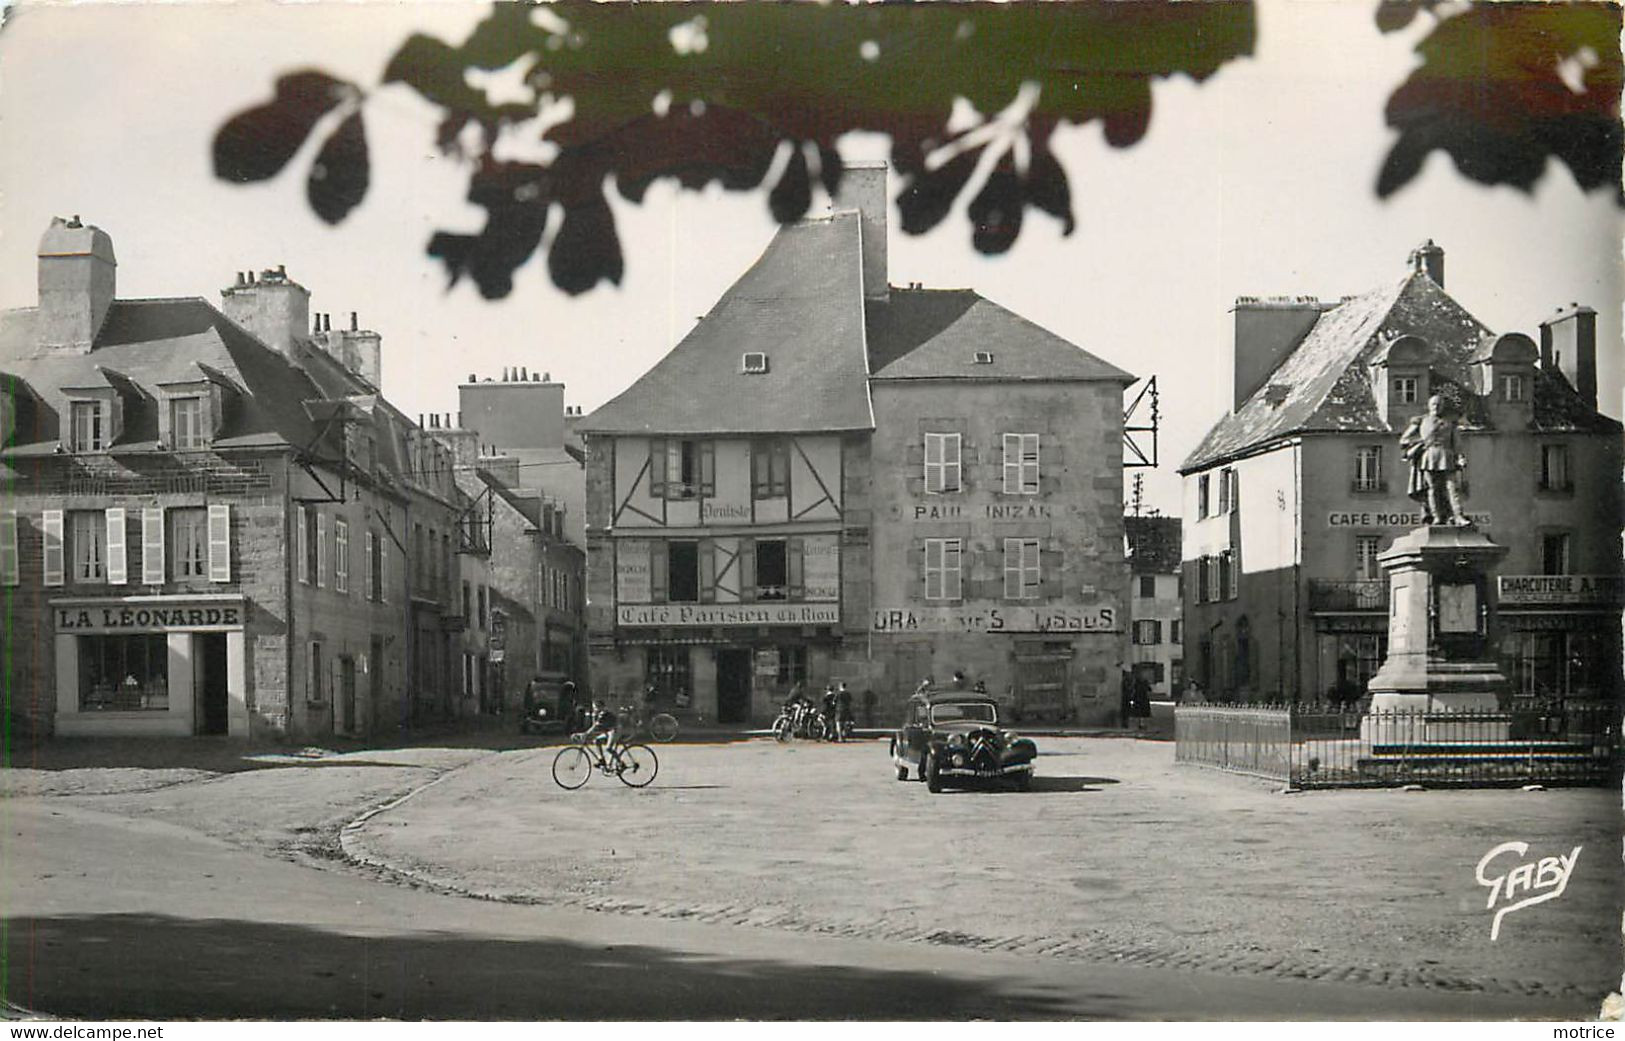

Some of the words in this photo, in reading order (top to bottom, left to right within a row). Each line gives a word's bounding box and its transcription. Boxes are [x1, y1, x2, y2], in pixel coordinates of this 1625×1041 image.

[986, 505, 1052, 519] INIZAN
[1329, 511, 1370, 526] CAFÉ
[1376, 513, 1420, 526] MODE
[1501, 577, 1573, 593] CHARCUTERIE
[59, 610, 93, 628] LA
[103, 606, 239, 627] LÉONARDE
[621, 606, 670, 624] Café
[679, 606, 770, 623] Parisien
